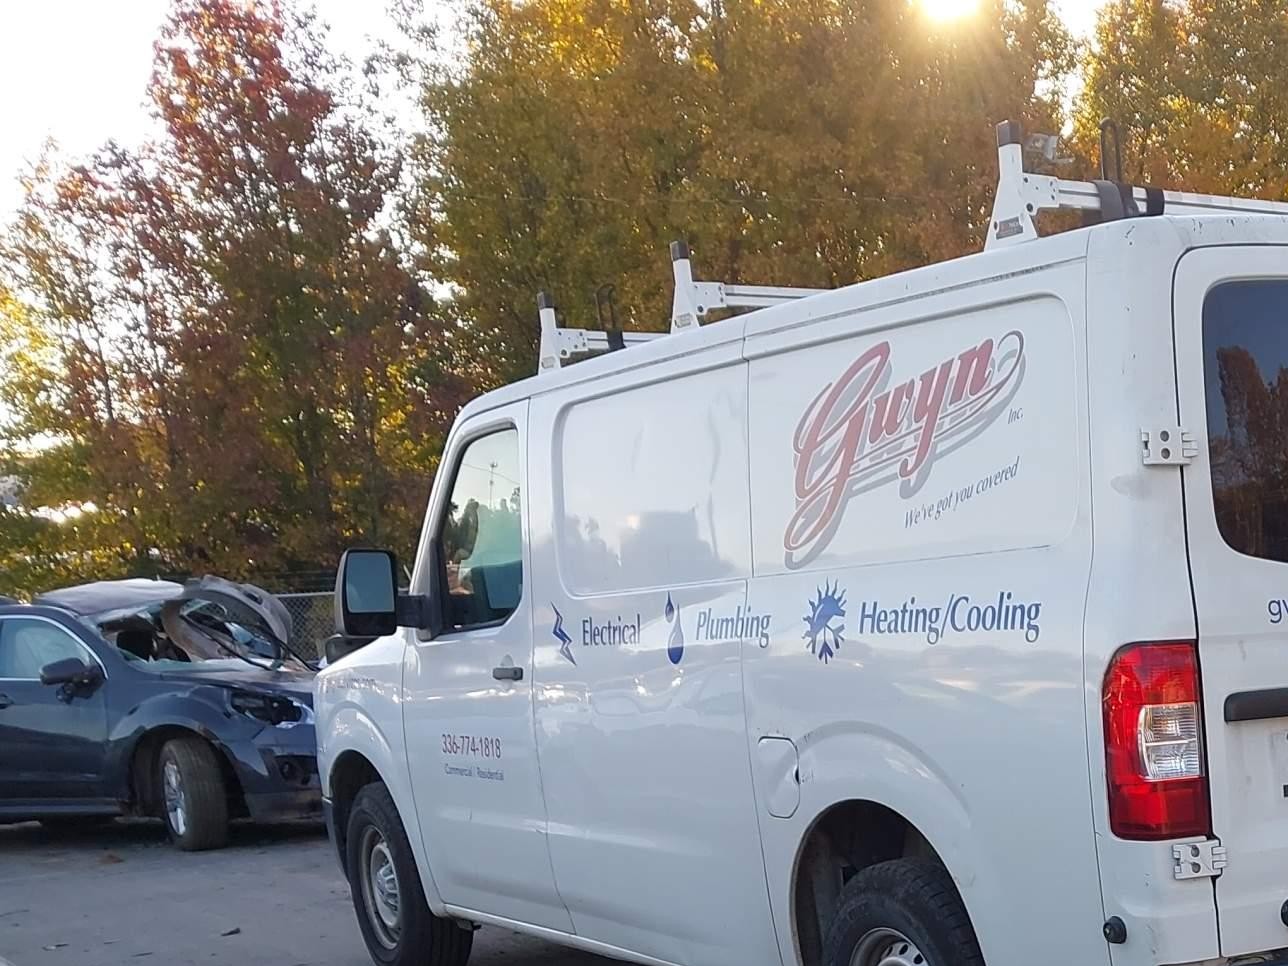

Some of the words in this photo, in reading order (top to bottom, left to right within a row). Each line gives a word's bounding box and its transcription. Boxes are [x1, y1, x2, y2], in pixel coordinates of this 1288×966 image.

[1007, 407, 1024, 425] Inc.
[784, 329, 1024, 563] Gwyn
[905, 503, 934, 528] We've
[935, 491, 953, 520] got
[953, 484, 974, 512] you
[976, 455, 1020, 495] covered
[582, 613, 641, 646] Electrical
[696, 605, 772, 648] Plumbing
[858, 591, 1042, 645] Heating/Cooling
[442, 734, 501, 759] 336-774-1818
